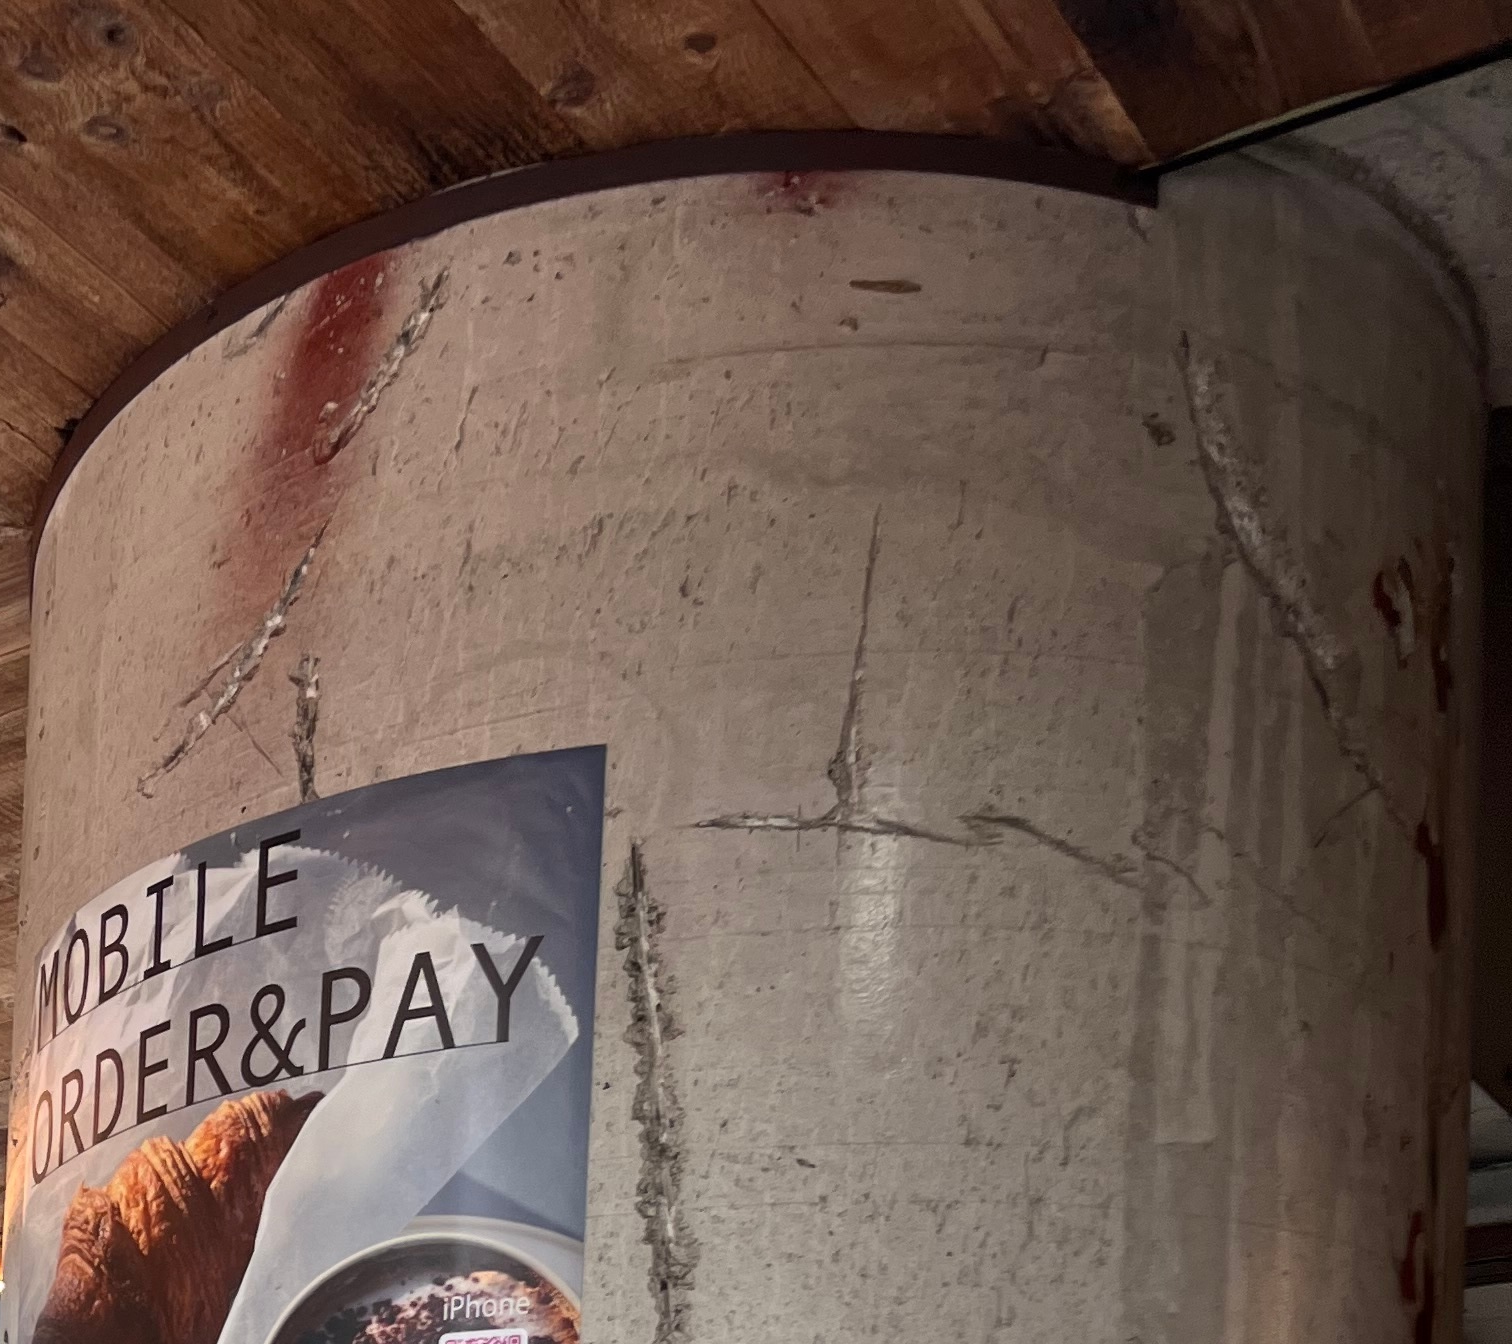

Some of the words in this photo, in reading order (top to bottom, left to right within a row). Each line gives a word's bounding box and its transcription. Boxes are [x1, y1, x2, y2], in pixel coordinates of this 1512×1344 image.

[37, 829, 301, 1051] MOBILE
[32, 935, 544, 1185] ORDER&PAY
[442, 1293, 531, 1321] iPhone
